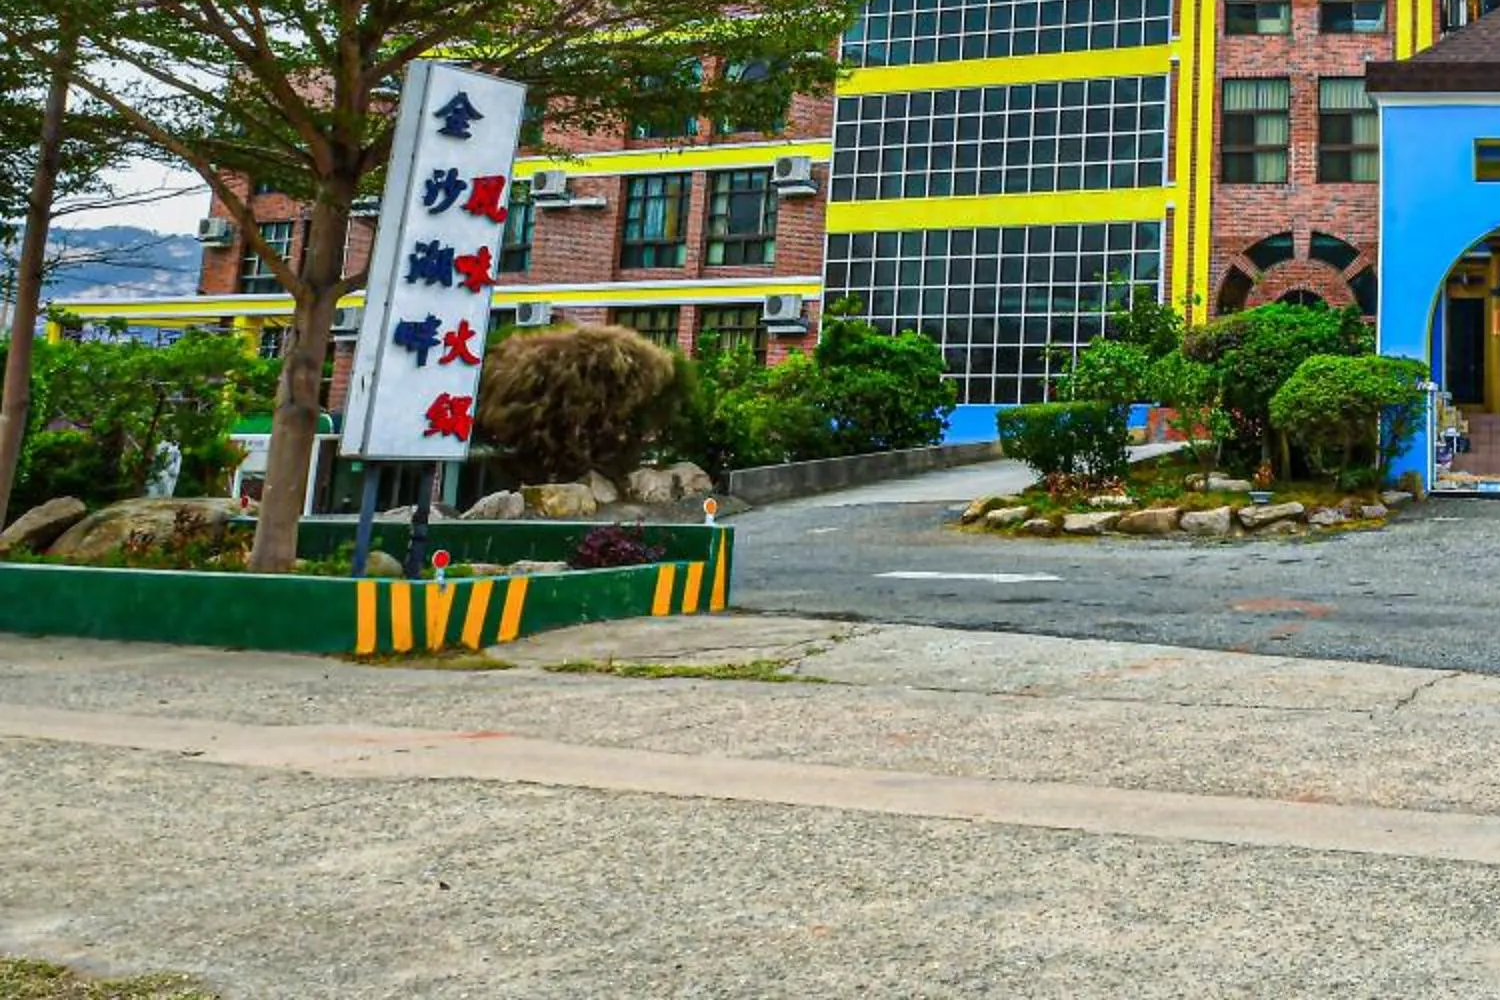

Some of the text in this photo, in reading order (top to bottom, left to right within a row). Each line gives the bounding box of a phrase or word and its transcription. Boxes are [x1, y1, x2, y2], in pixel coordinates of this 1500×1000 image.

[394, 90, 483, 367] 金沙湖畔
[423, 174, 508, 441] 風味火鍋
